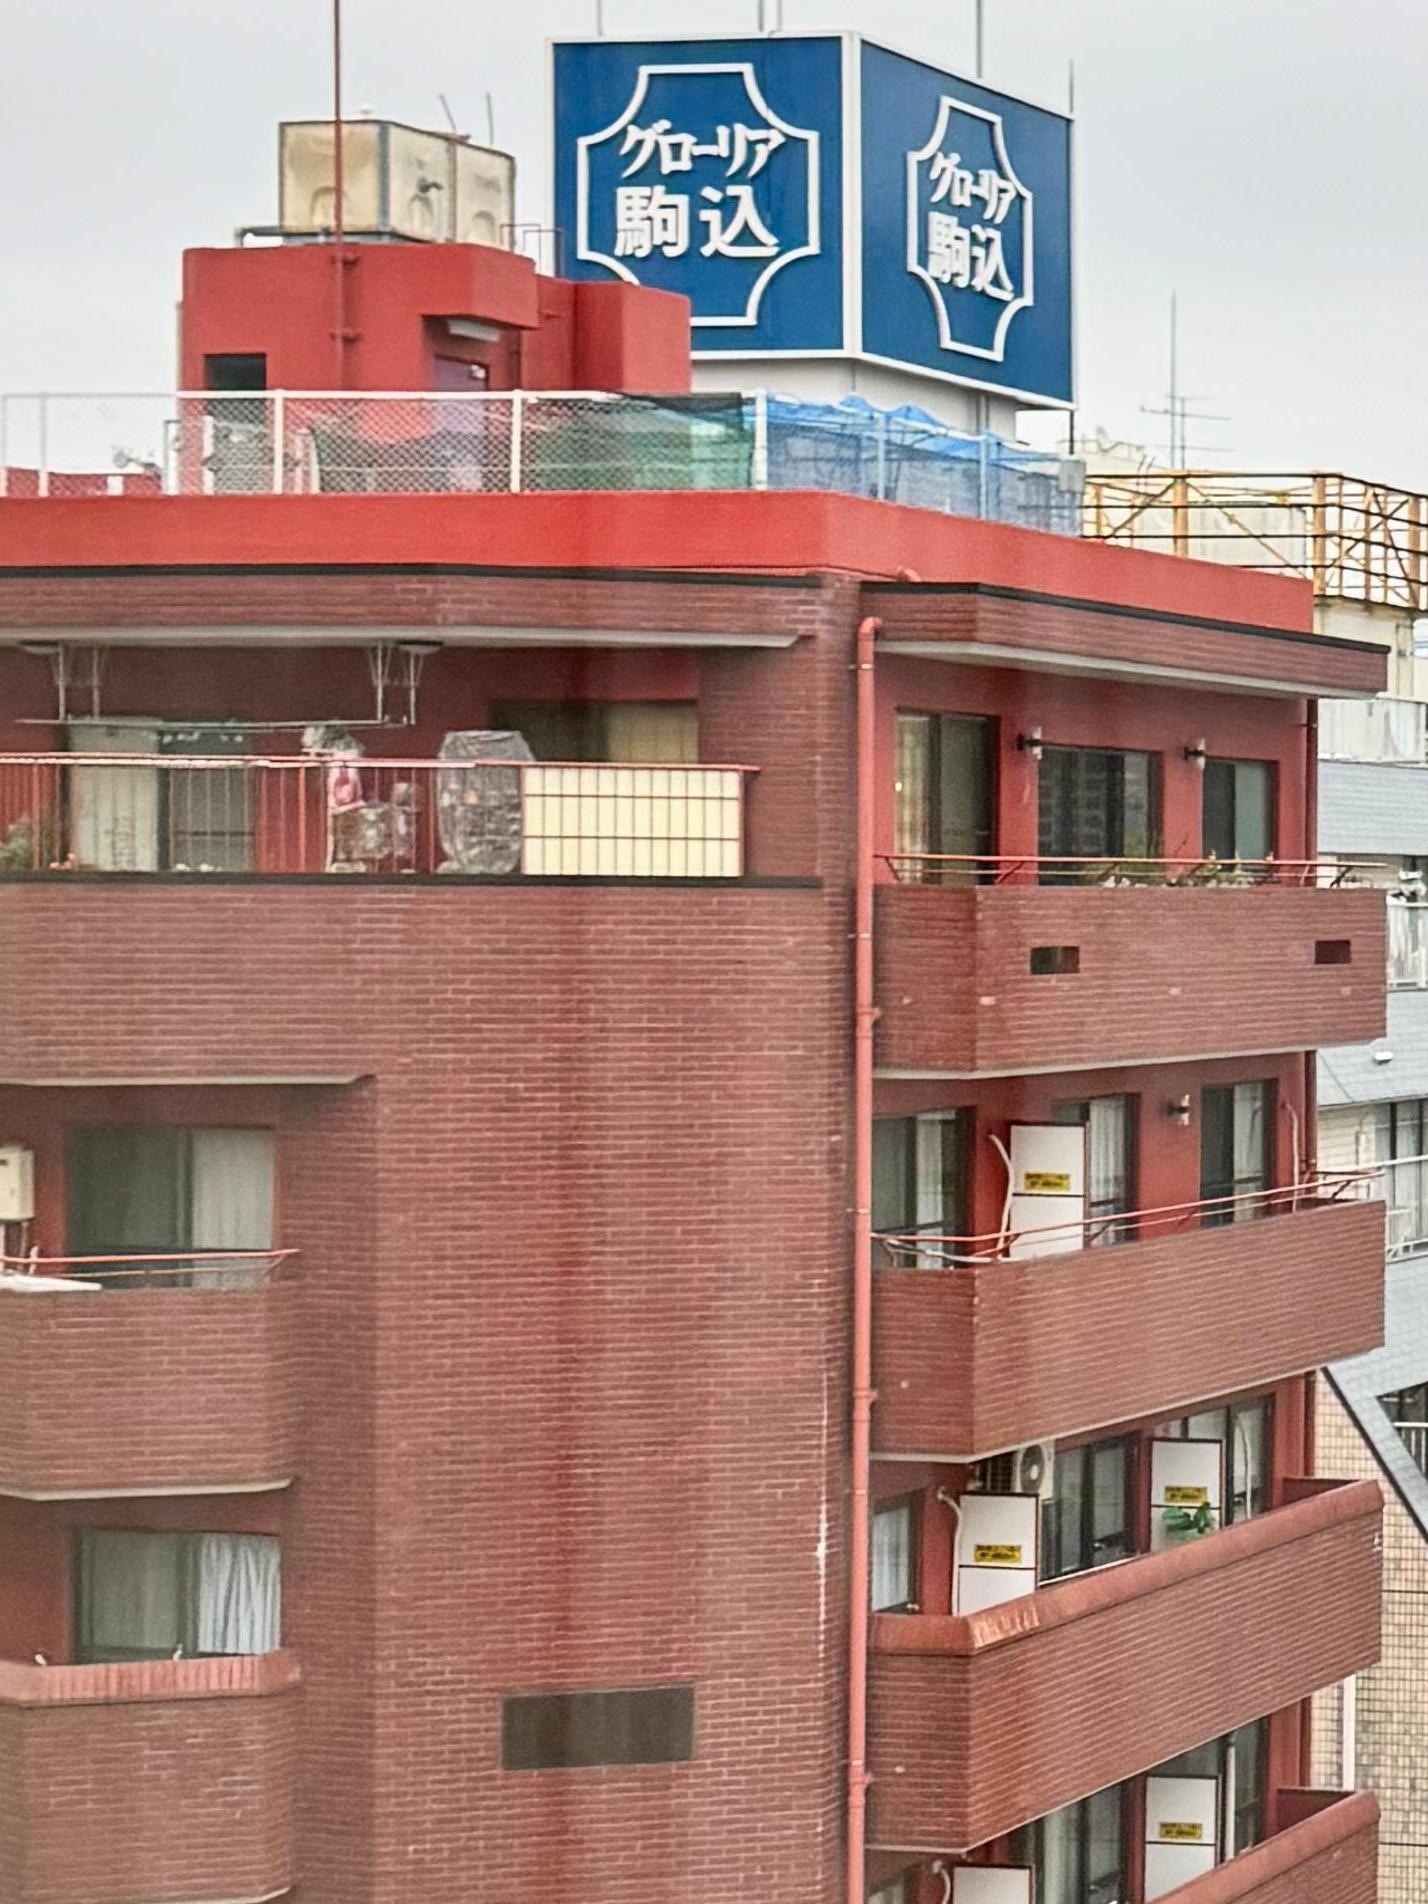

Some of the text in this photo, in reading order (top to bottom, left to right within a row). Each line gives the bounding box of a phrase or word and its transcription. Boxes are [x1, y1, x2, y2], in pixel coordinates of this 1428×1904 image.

[619, 119, 785, 178] グローリア
[615, 186, 780, 259] 駒込
[929, 151, 1018, 224] グローリア
[927, 211, 1014, 302] 駒込
